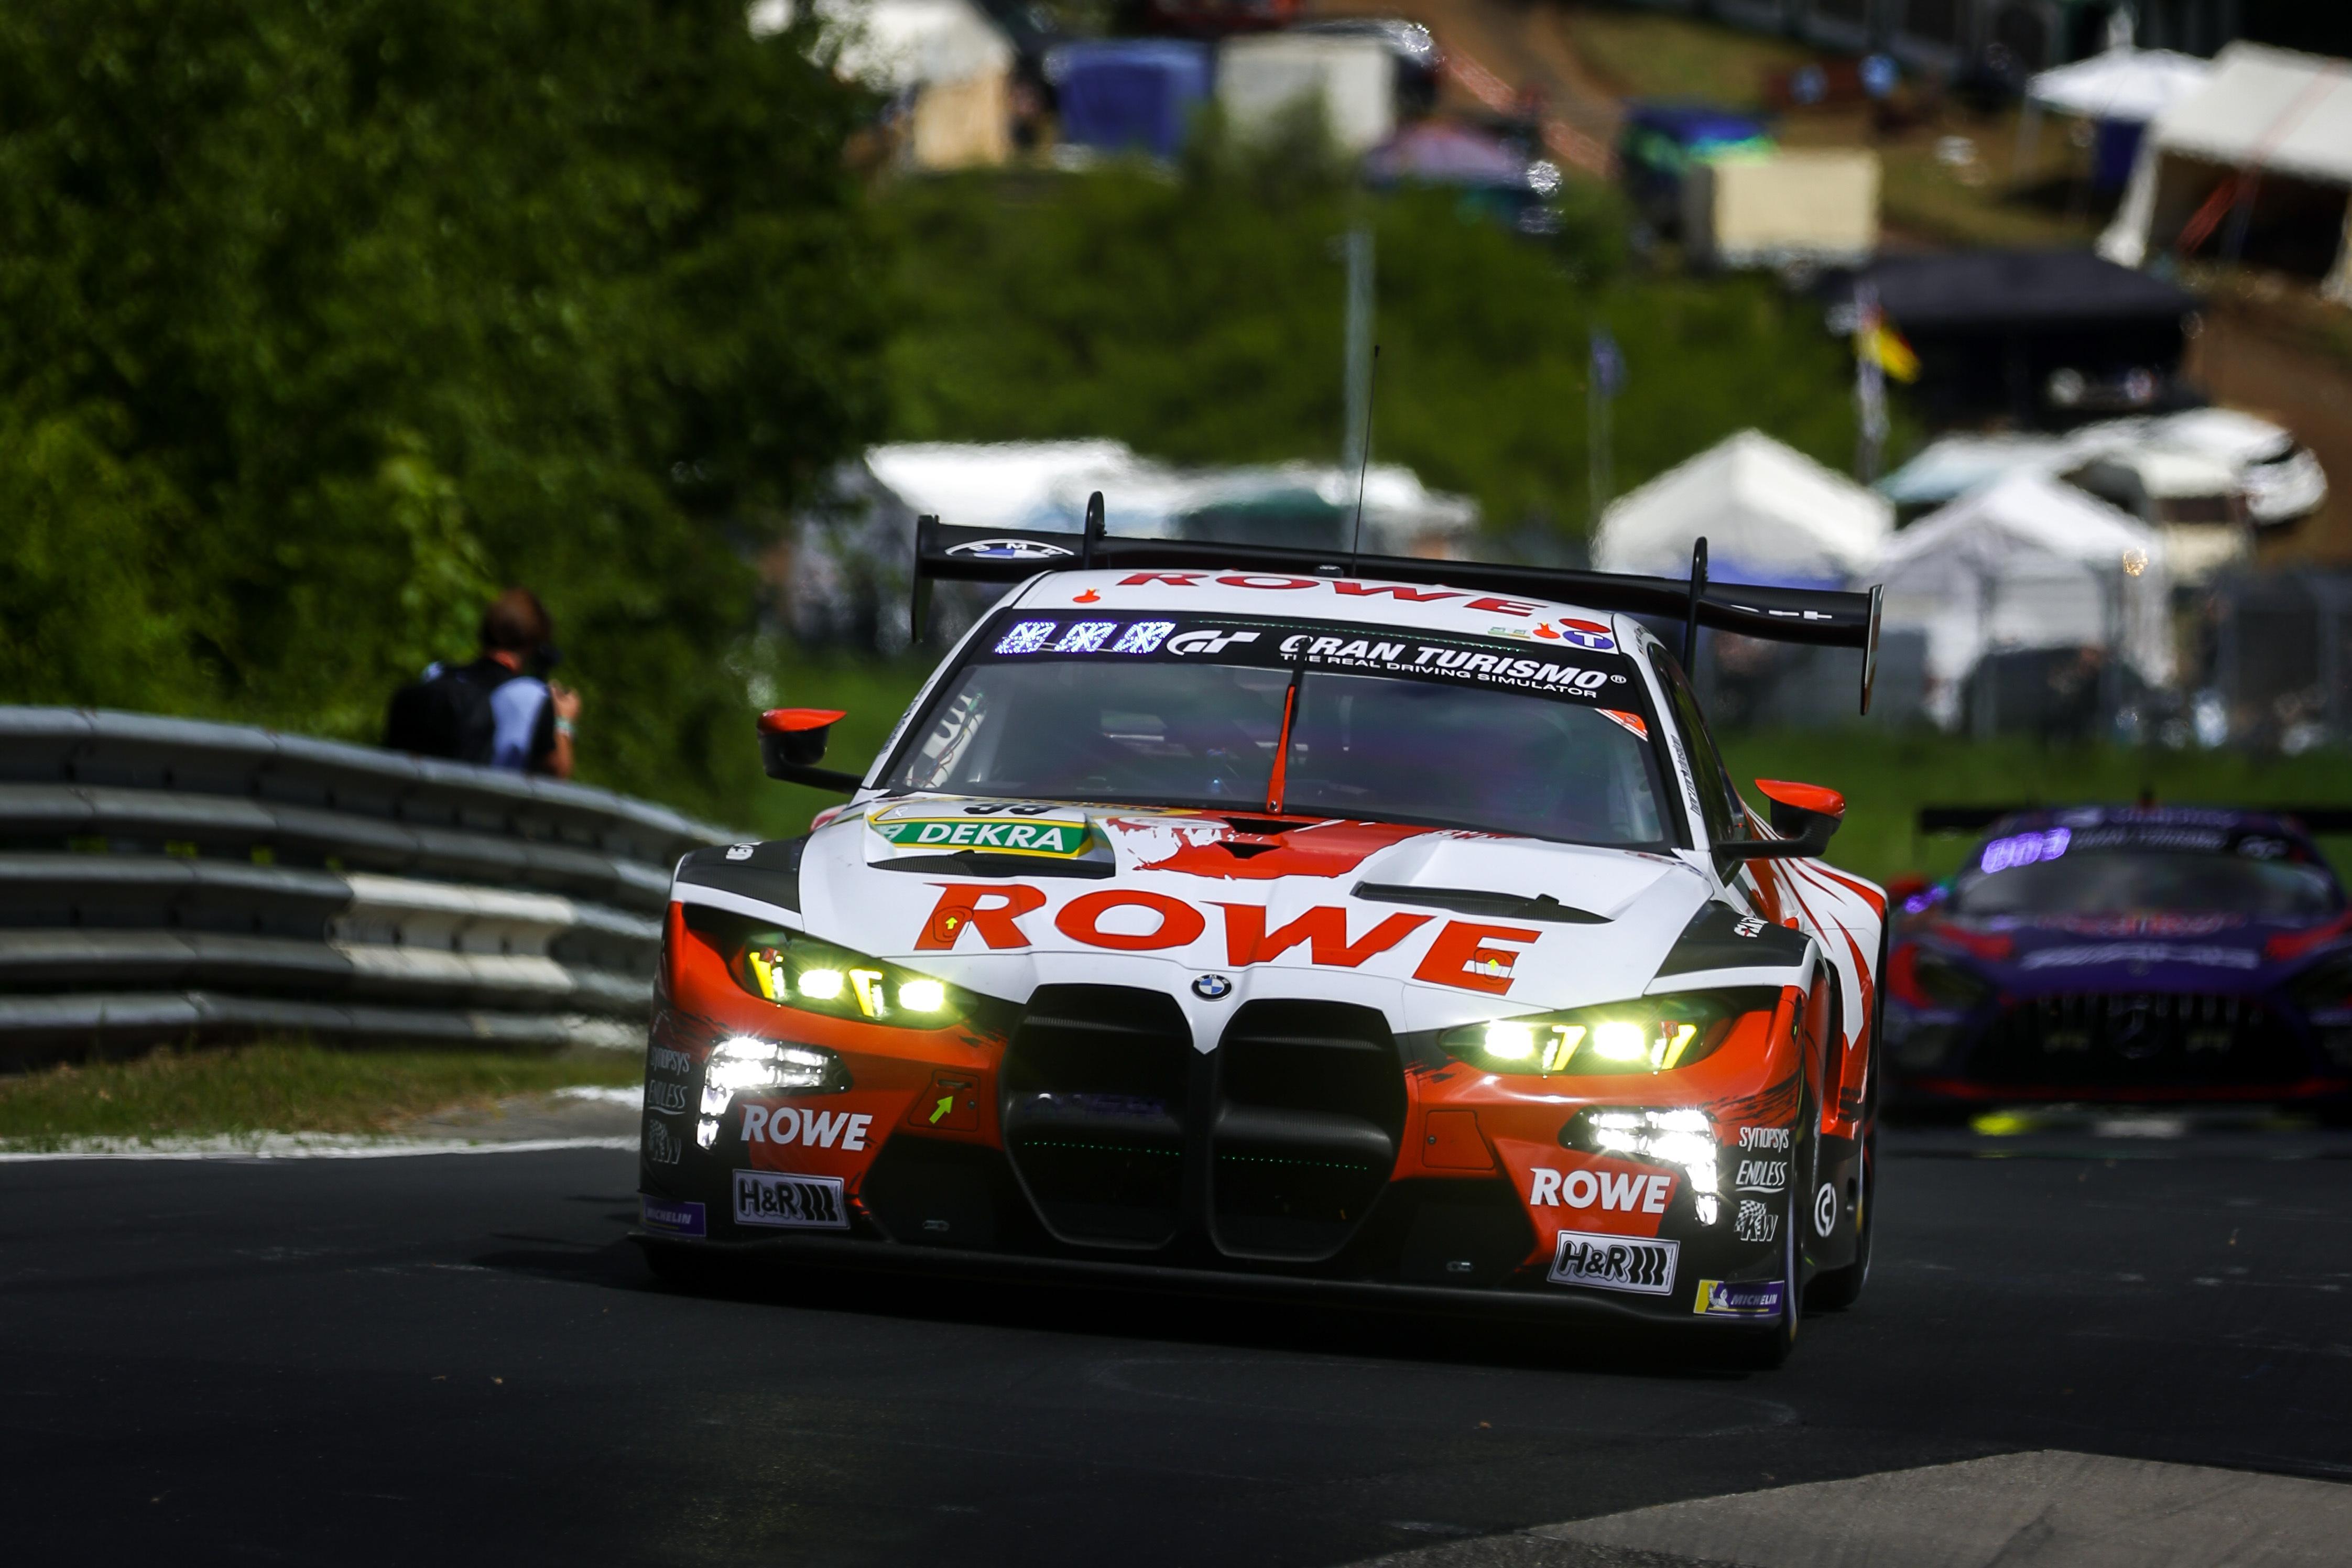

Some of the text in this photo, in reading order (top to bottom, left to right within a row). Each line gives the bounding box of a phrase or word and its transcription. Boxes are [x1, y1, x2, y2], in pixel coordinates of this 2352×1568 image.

[1116, 572, 1549, 617] ROWE
[1279, 634, 1406, 661] GRAN
[1414, 646, 1608, 689] TURISMO
[1327, 657, 1381, 669] REAL
[1387, 662, 1471, 679] DRIVING
[1477, 672, 1597, 699] SIMULATOR
[917, 823, 1064, 852] DEKRA
[913, 883, 1543, 996] ROWE
[741, 1104, 873, 1151] ROWE
[1739, 1126, 1789, 1153] SYNOPSYS
[1530, 1168, 1671, 1214] ROWE
[1736, 1159, 1788, 1186] ENDLESS
[739, 1178, 800, 1216] H&R
[1740, 1214, 1779, 1242] KW
[1558, 1242, 1628, 1278] H&R
[1730, 1294, 1778, 1305] MICHELIN
